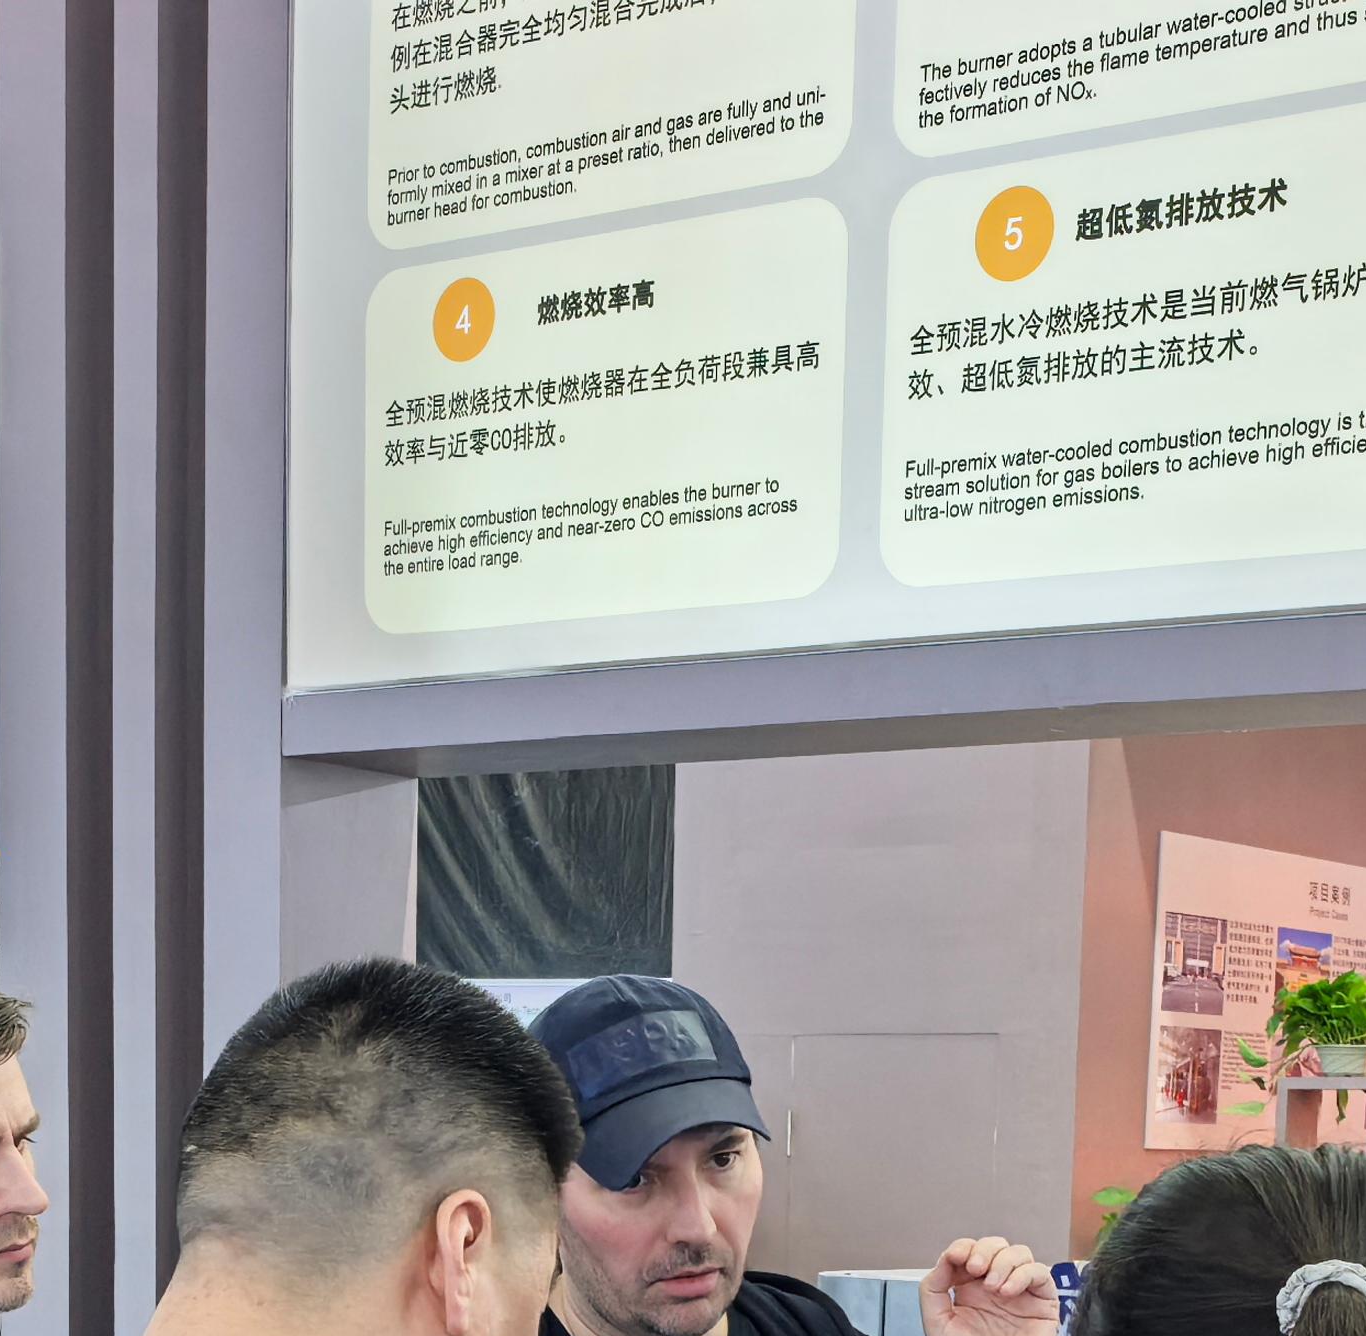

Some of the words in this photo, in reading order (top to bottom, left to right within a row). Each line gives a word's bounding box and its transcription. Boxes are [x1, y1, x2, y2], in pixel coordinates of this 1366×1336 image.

[1003, 216, 1023, 251] 5
[1074, 177, 1288, 242] 超低氮排放技术
[455, 304, 472, 334] 4
[537, 278, 656, 326] 燃烧效率高
[385, 340, 820, 428] 全预混燃烧技术使燃烧器在全负荷段兼具高
[907, 328, 1258, 401] 效、超低氮排放的主流技术。
[904, 481, 960, 501] stream
[965, 472, 1031, 494] solution
[1035, 467, 1060, 488] for
[1063, 467, 1096, 489] gas
[1101, 458, 1160, 480] boilers
[1164, 455, 1183, 474] to
[1187, 447, 1260, 472] achieve
[1265, 440, 1305, 466] high
[905, 454, 997, 480] Full-premix
[1001, 438, 1113, 469] water-cooled
[1118, 429, 1222, 456] combustion
[1227, 416, 1332, 444] technology
[1337, 415, 1353, 432] is
[383, 516, 457, 539] Full-premix
[459, 505, 537, 529] combustion
[541, 497, 619, 520] technology
[621, 488, 680, 511] enables
[683, 485, 707, 504] the
[711, 481, 762, 500] burner
[764, 477, 780, 494] to
[383, 538, 434, 557] achieve
[437, 532, 466, 554] high
[469, 527, 534, 548] efficiency
[536, 521, 563, 541] and
[567, 517, 636, 537] near-zero
[640, 509, 665, 529] CO
[669, 504, 743, 526] emissions
[747, 498, 798, 518] across
[904, 500, 974, 523] ultra-low
[978, 495, 1047, 517] nitrogen
[1052, 484, 1144, 508] emissions.
[383, 559, 404, 577] the
[407, 555, 445, 575] entire
[448, 551, 477, 571] load
[480, 550, 523, 569] range.
